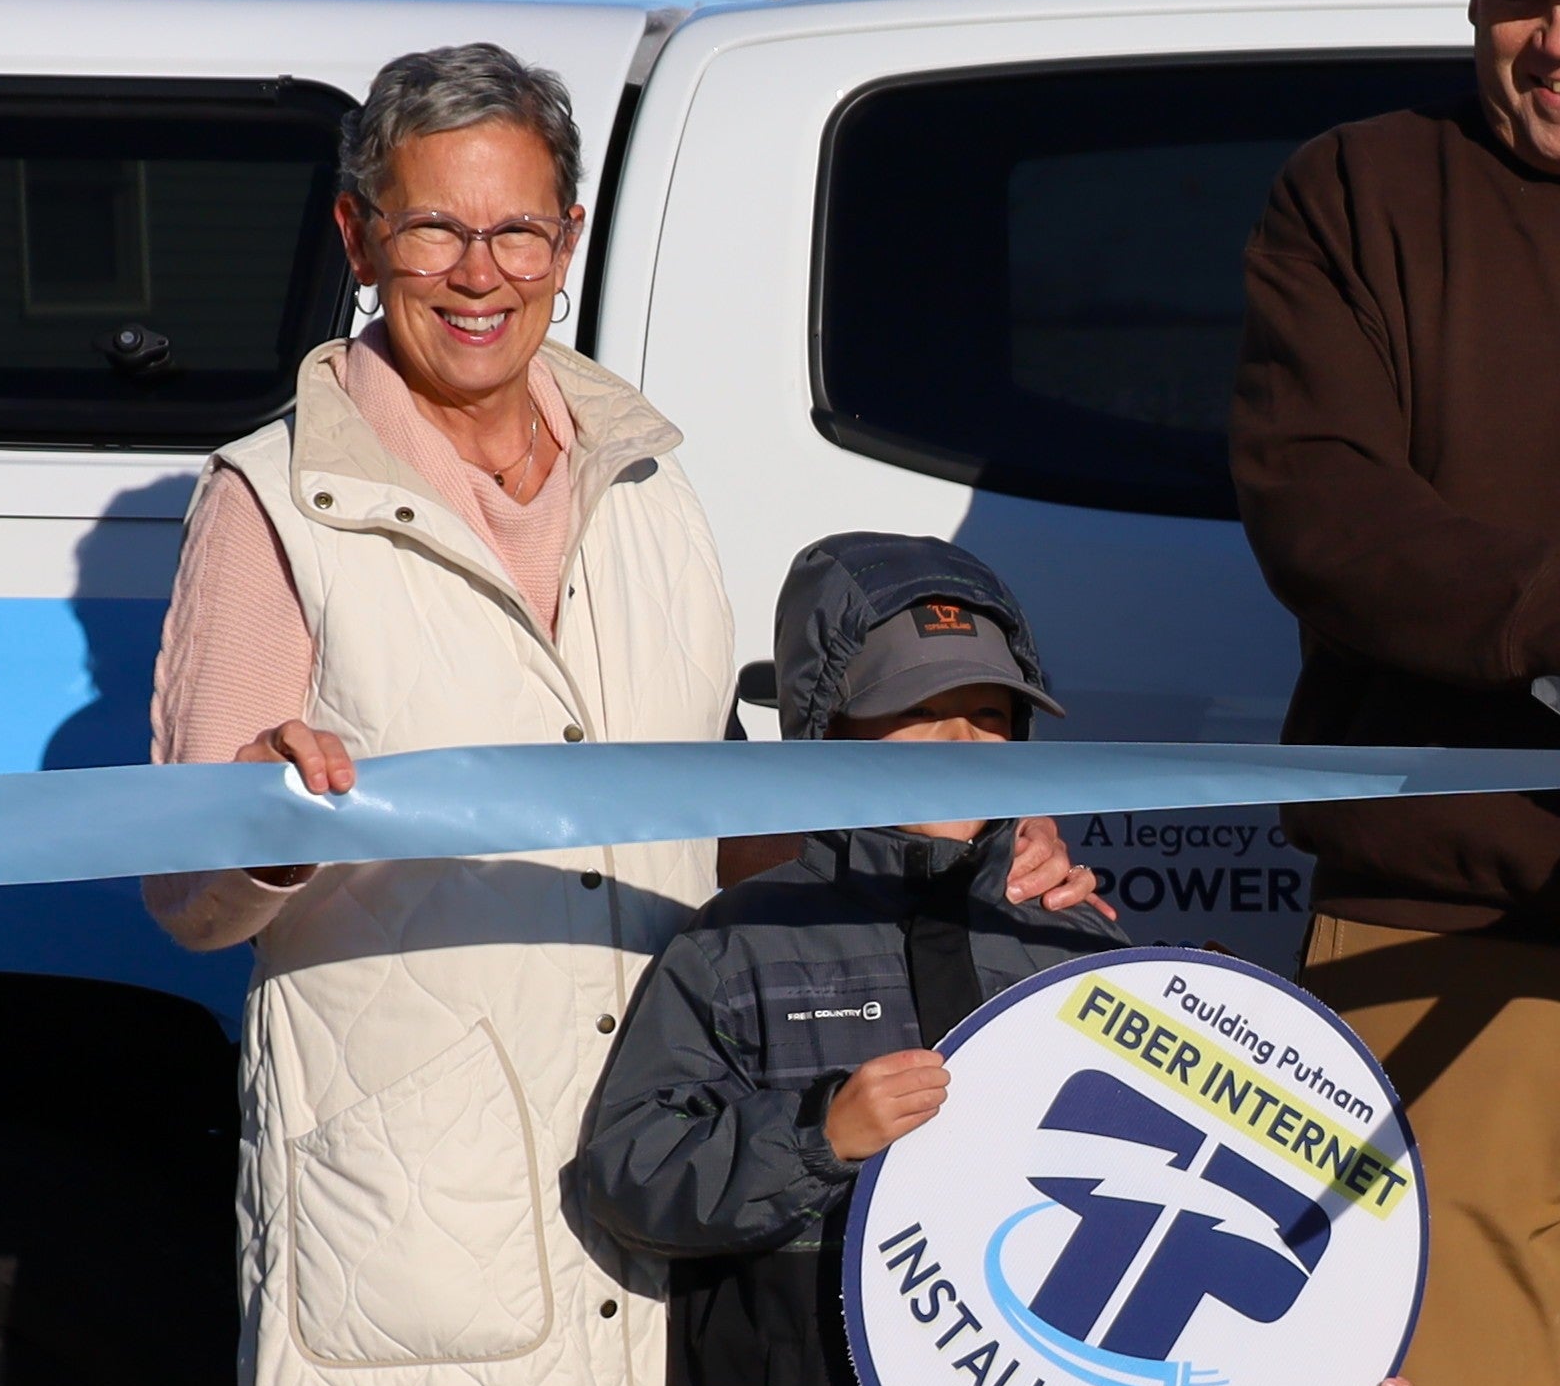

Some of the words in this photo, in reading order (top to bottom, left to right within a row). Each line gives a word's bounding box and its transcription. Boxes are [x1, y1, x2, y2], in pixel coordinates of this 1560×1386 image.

[1081, 814, 1113, 847] A
[1124, 814, 1258, 857] legacy
[1267, 825, 1289, 848] o
[1076, 985, 1201, 1083] FIBER
[1198, 1061, 1408, 1208] INTERNET
[1162, 974, 1276, 1065] Paulding
[1276, 1050, 1375, 1124] Putnam
